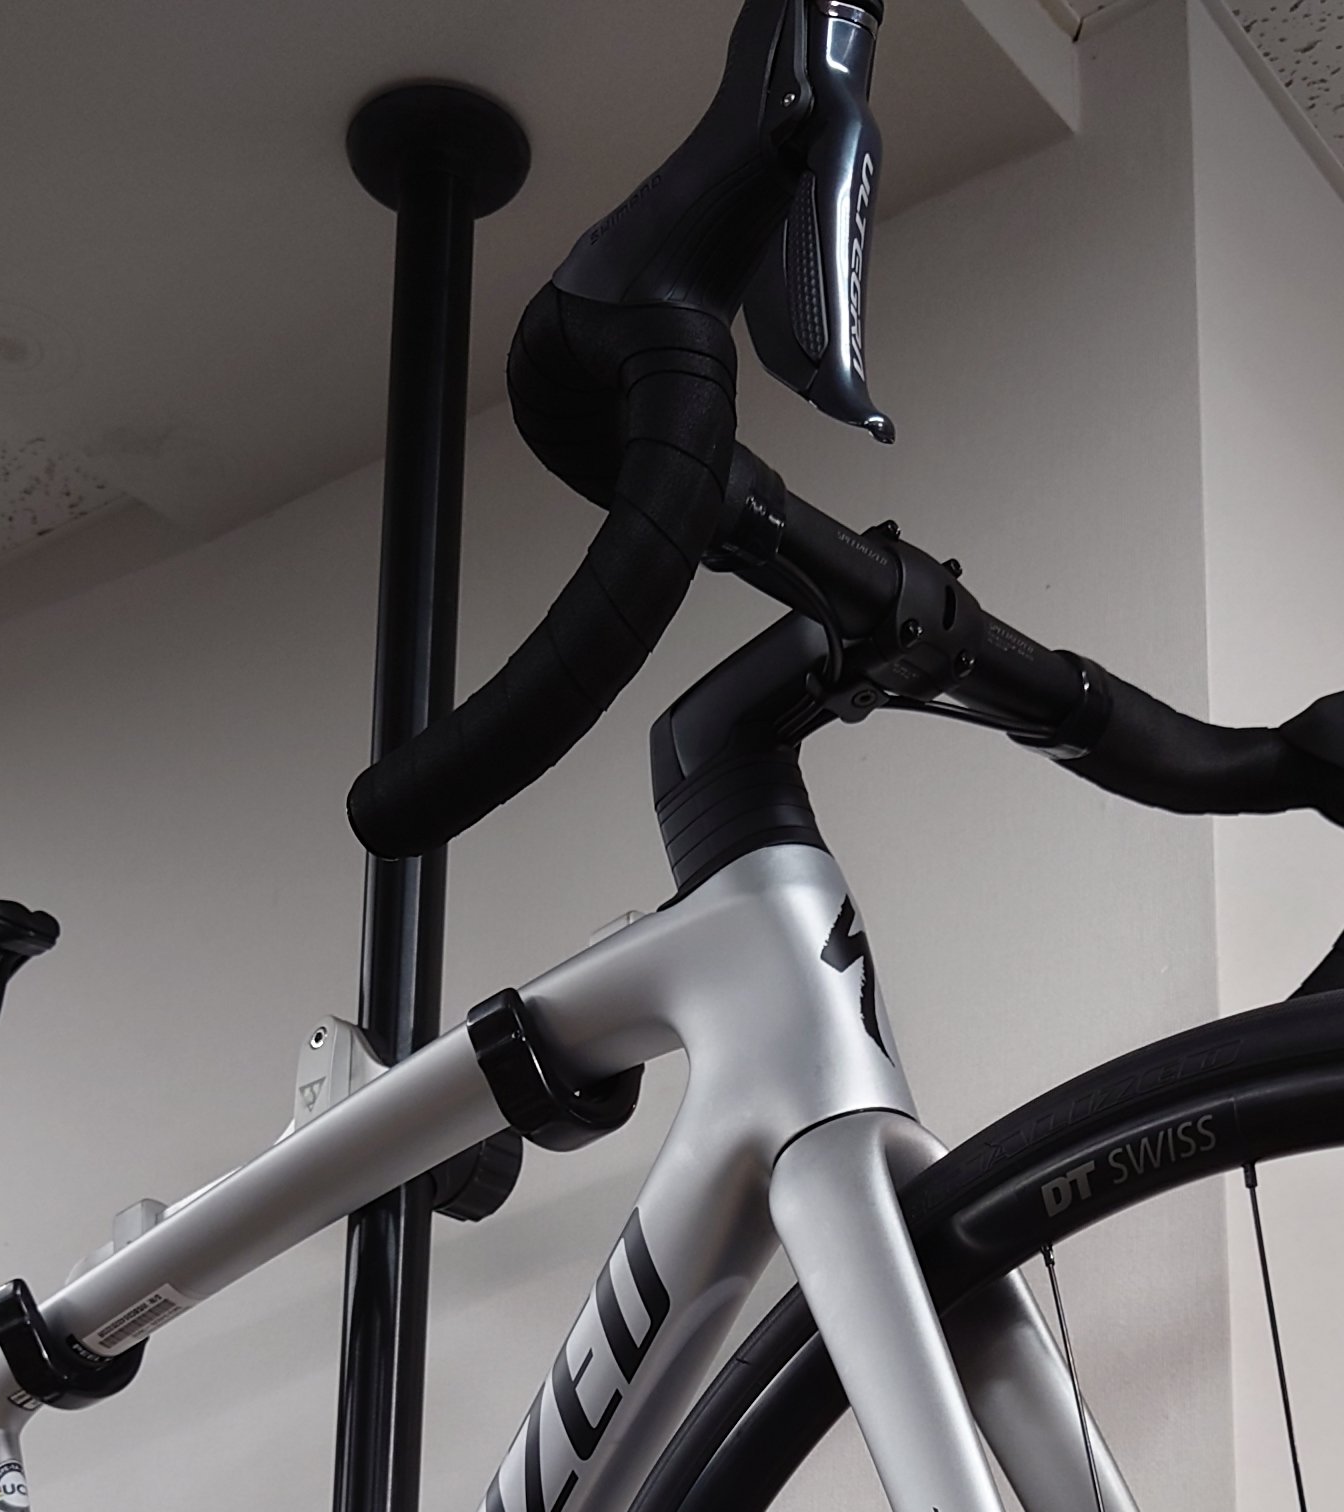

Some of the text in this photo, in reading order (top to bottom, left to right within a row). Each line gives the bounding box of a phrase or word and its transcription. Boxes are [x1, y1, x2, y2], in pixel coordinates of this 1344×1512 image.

[850, 153, 874, 382] ULTEGRA
[1040, 1113, 1217, 1219] DT SWISS
